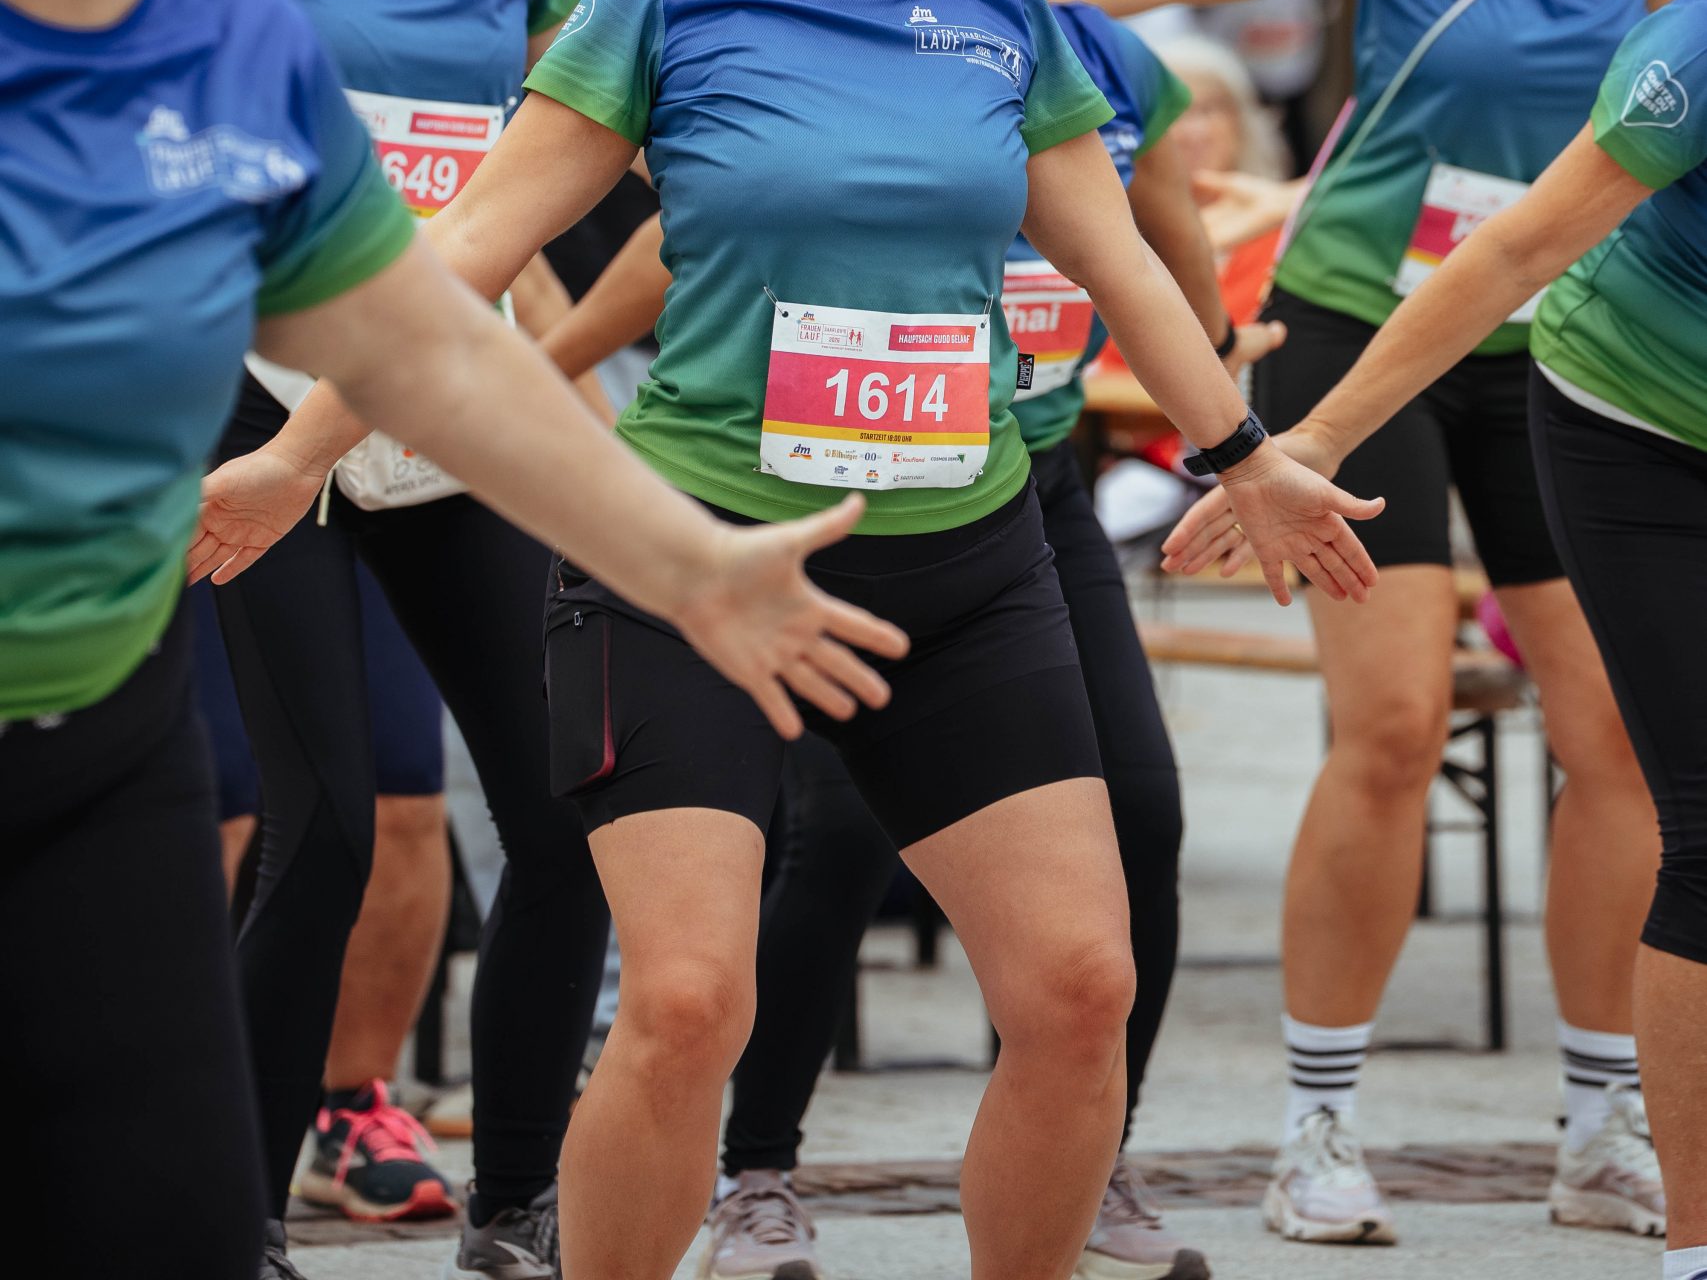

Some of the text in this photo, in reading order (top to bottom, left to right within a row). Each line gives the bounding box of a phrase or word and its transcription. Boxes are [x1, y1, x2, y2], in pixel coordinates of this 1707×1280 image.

[912, 5, 932, 17] dm
[921, 31, 960, 51] LAUF
[1654, 95, 1669, 112] DU
[800, 324, 822, 332] FRAUEN
[799, 331, 821, 341] LAUF
[898, 334, 933, 344] HAUPTSACH
[825, 368, 948, 422] 1614
[860, 432, 887, 441] STARTZEIT
[793, 444, 811, 455] dm
